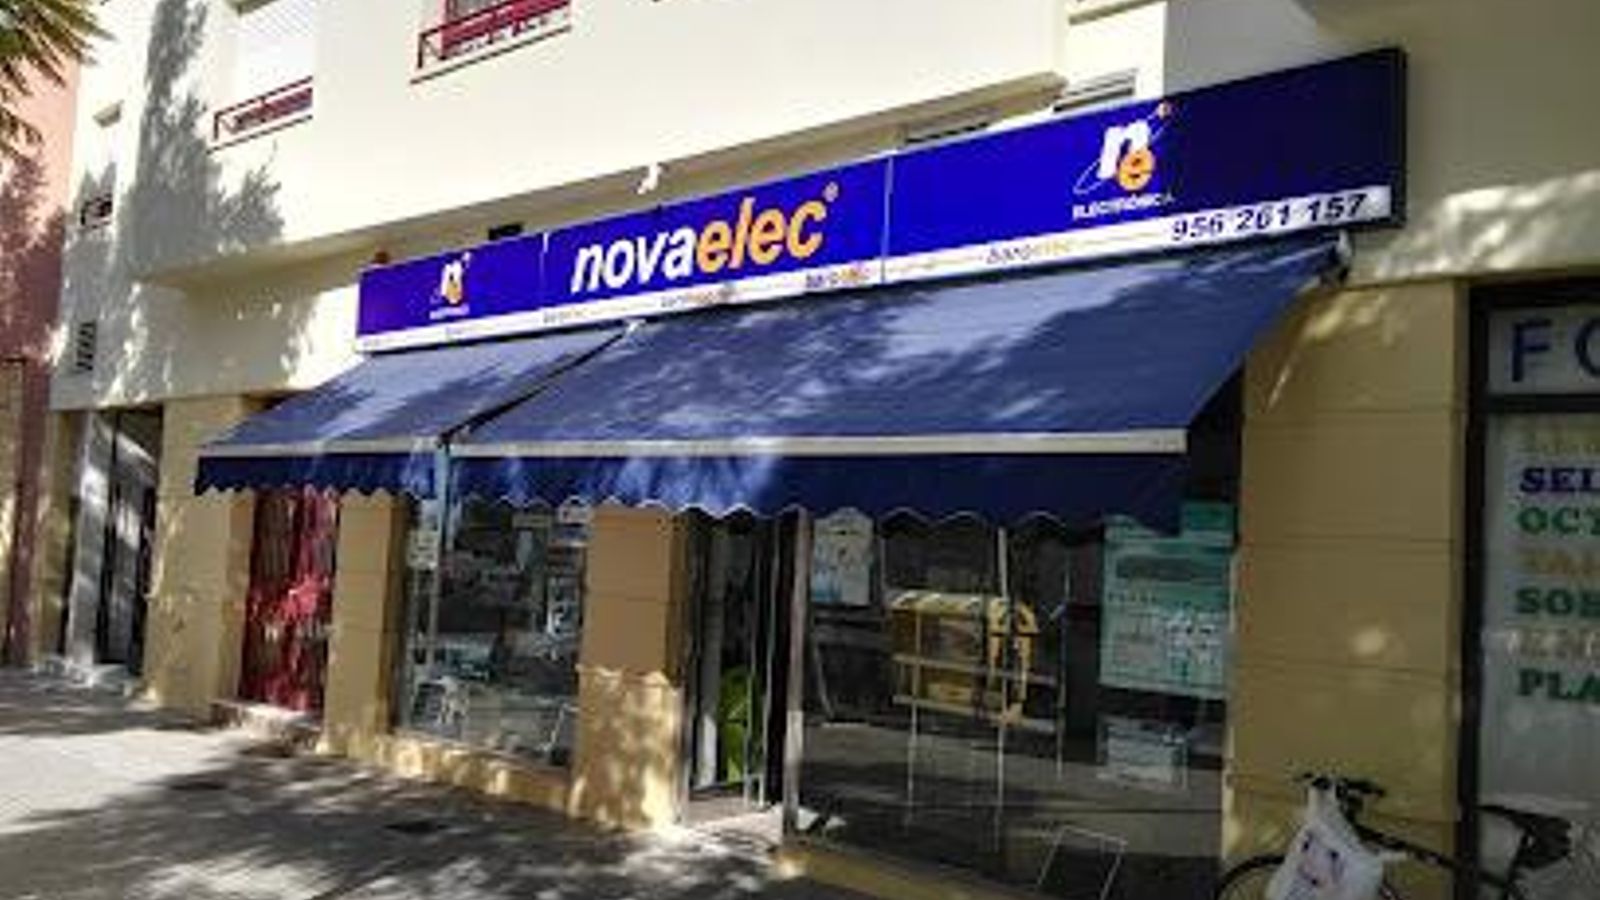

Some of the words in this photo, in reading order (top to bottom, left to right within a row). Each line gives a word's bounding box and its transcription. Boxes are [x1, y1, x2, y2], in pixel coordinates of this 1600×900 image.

[570, 197, 827, 293] novaelec
[1172, 213, 1223, 240] 956
[1236, 204, 1291, 231] 261
[1307, 193, 1367, 222] 157
